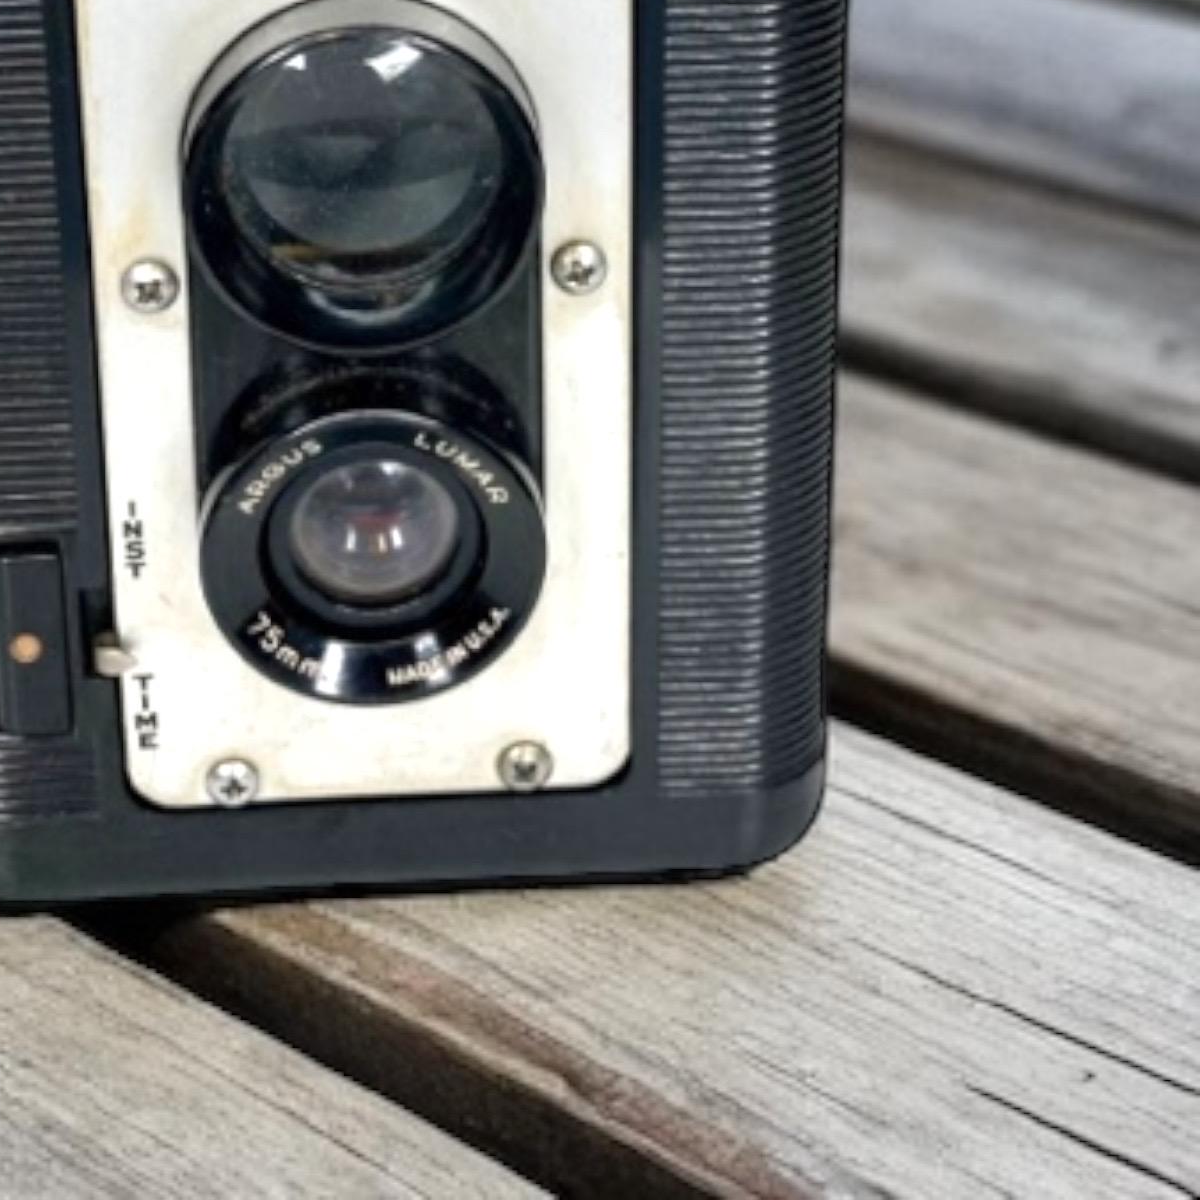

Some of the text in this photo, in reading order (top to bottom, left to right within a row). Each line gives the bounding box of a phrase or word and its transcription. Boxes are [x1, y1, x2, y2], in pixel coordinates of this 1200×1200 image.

[237, 432, 509, 515] ARGUS LUMAR
[122, 500, 146, 578] INST
[247, 610, 326, 681] 75mm
[132, 673, 159, 749] TIME
